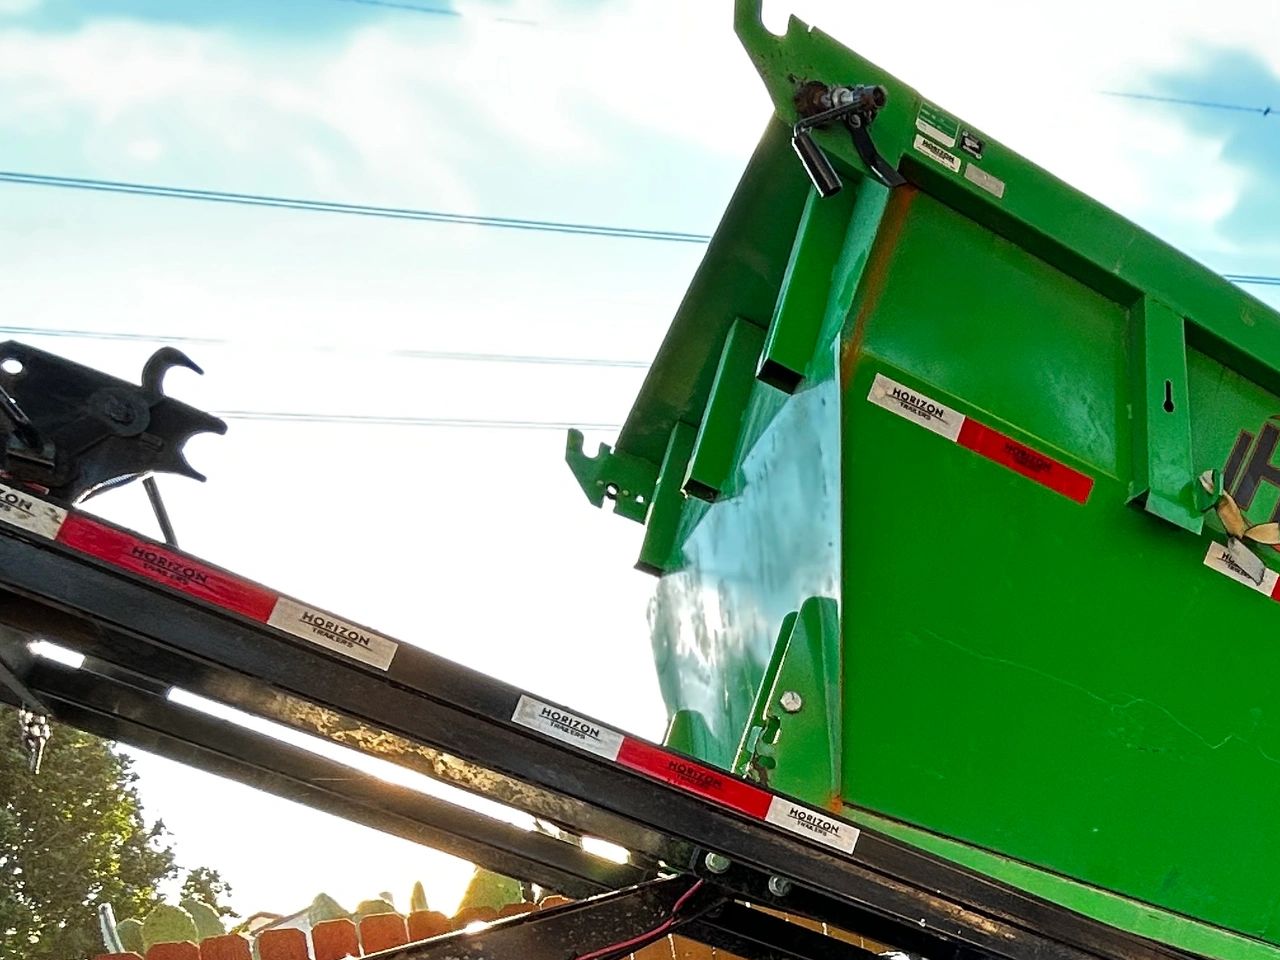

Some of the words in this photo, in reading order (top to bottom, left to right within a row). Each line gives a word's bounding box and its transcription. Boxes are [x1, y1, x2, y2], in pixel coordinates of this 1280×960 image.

[892, 386, 944, 418] HORIZON
[131, 546, 209, 583] HORIZON
[301, 611, 371, 646] HORIZON
[312, 627, 354, 649] TRAILERS
[541, 707, 600, 738] HORIZON
[550, 720, 586, 740] TRAILERS
[789, 807, 840, 834] HORIZON
